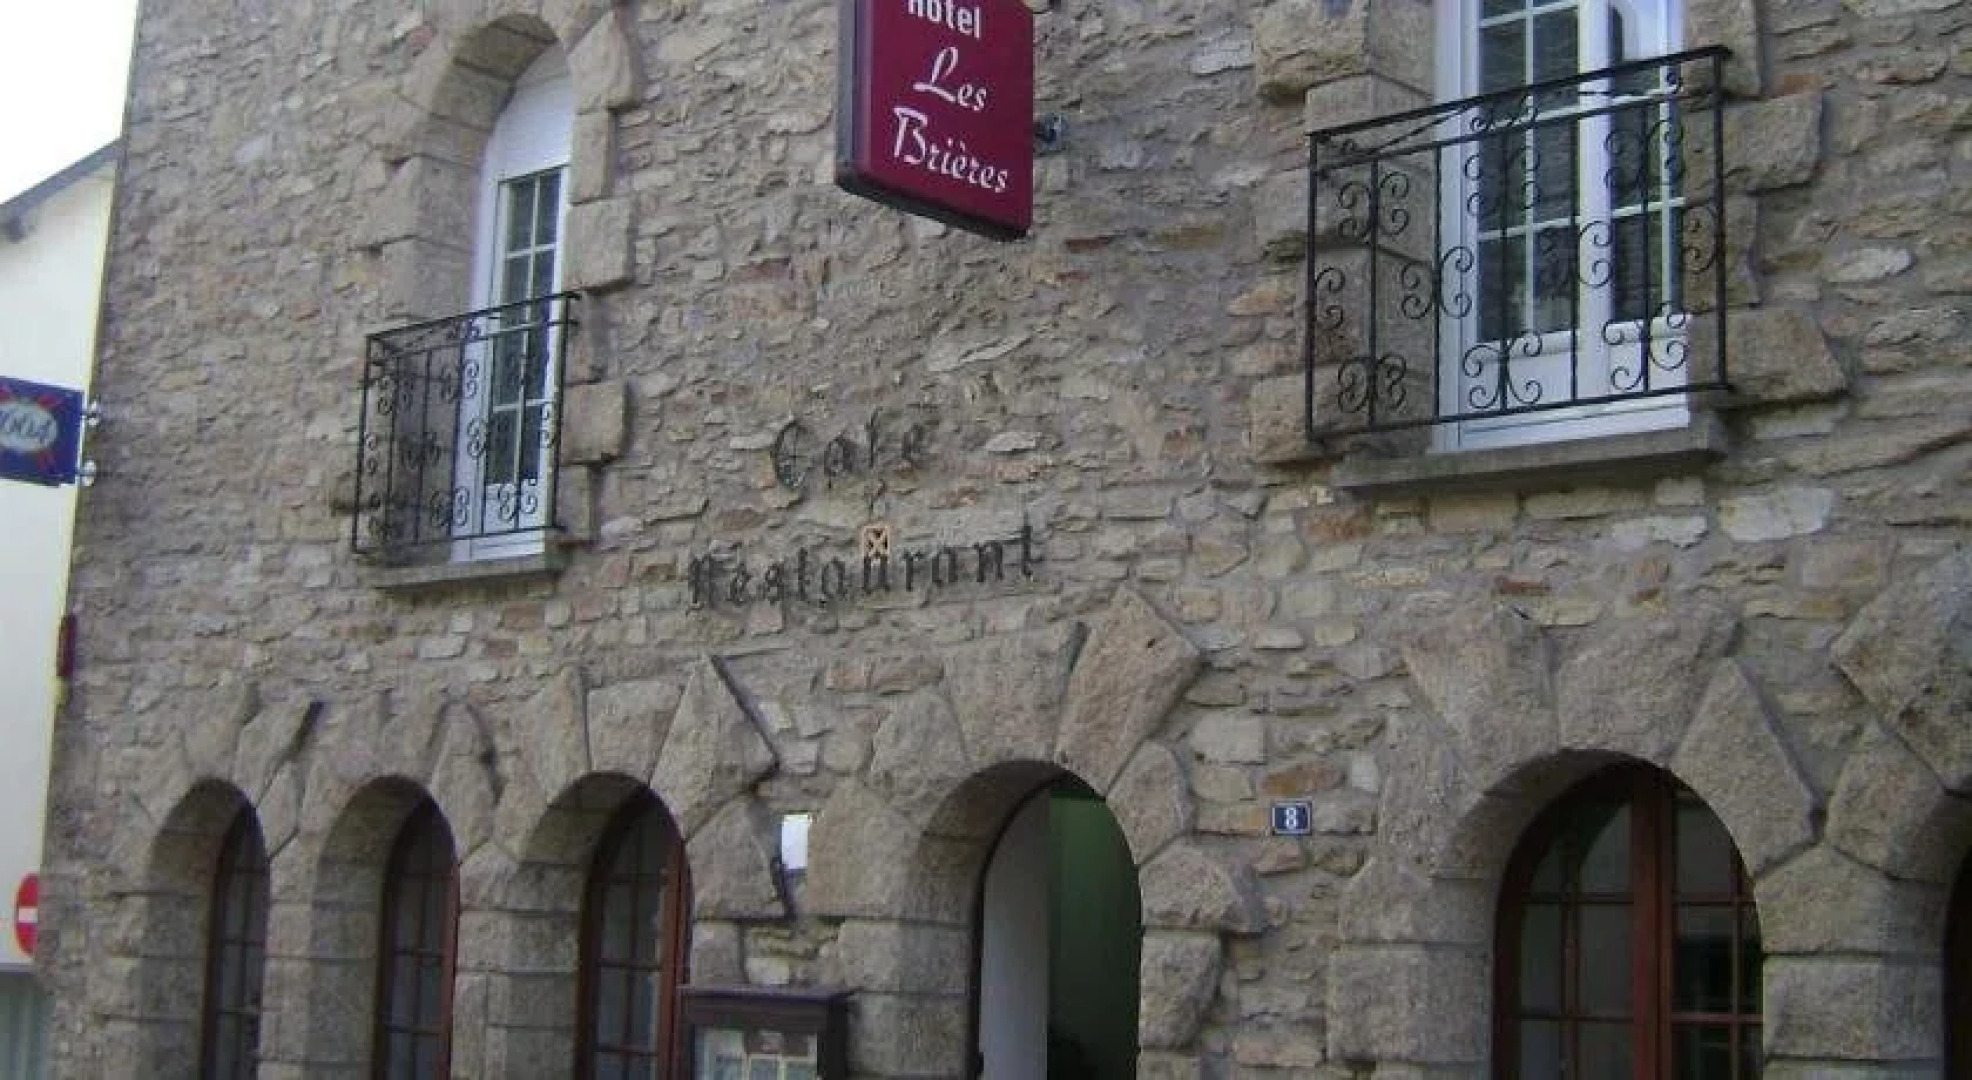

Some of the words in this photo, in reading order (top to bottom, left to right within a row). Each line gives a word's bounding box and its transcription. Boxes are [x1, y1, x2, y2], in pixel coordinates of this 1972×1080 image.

[912, 46, 987, 111] Les
[893, 106, 1008, 193] Brières
[1284, 807, 1298, 830] 8
